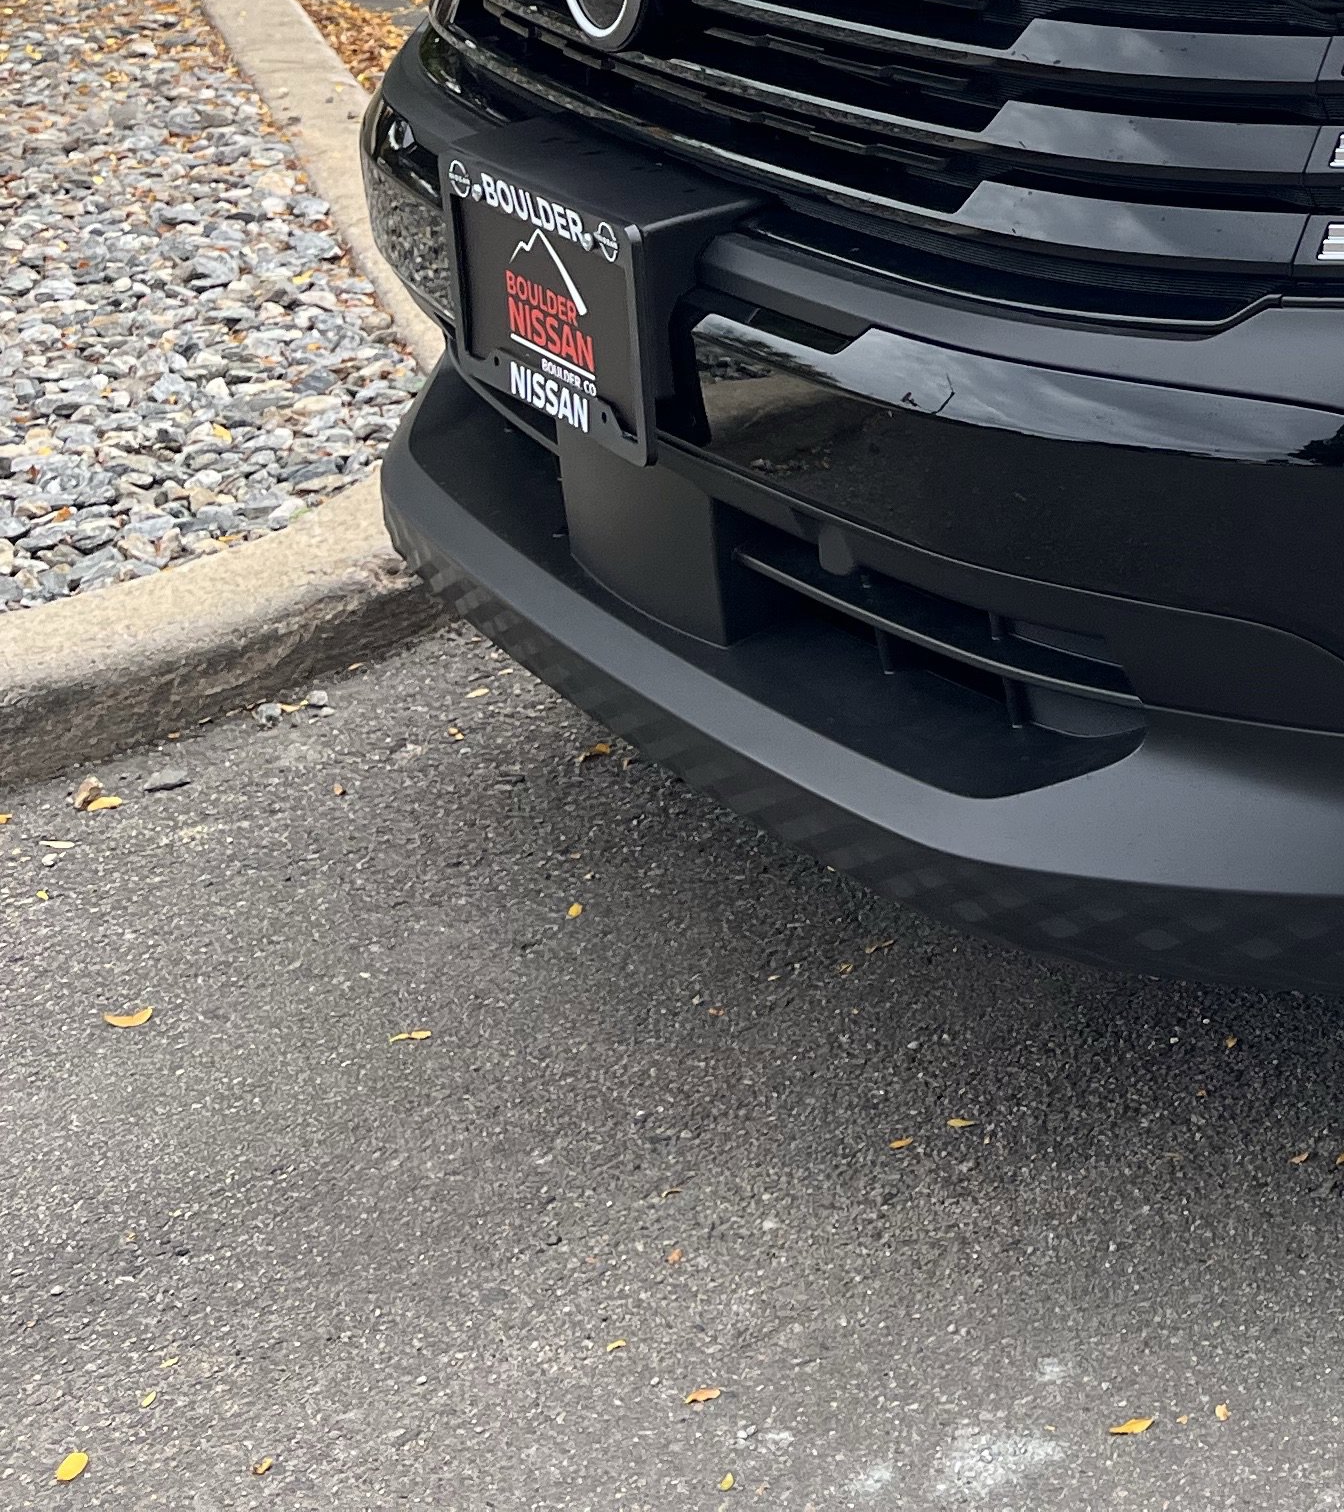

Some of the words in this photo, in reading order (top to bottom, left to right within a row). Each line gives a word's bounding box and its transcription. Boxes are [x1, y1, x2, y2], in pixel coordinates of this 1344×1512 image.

[480, 172, 585, 243] BOULDER
[505, 269, 578, 326] BOULDER
[508, 296, 595, 372] NISSAN
[510, 361, 589, 434] NISSAN
